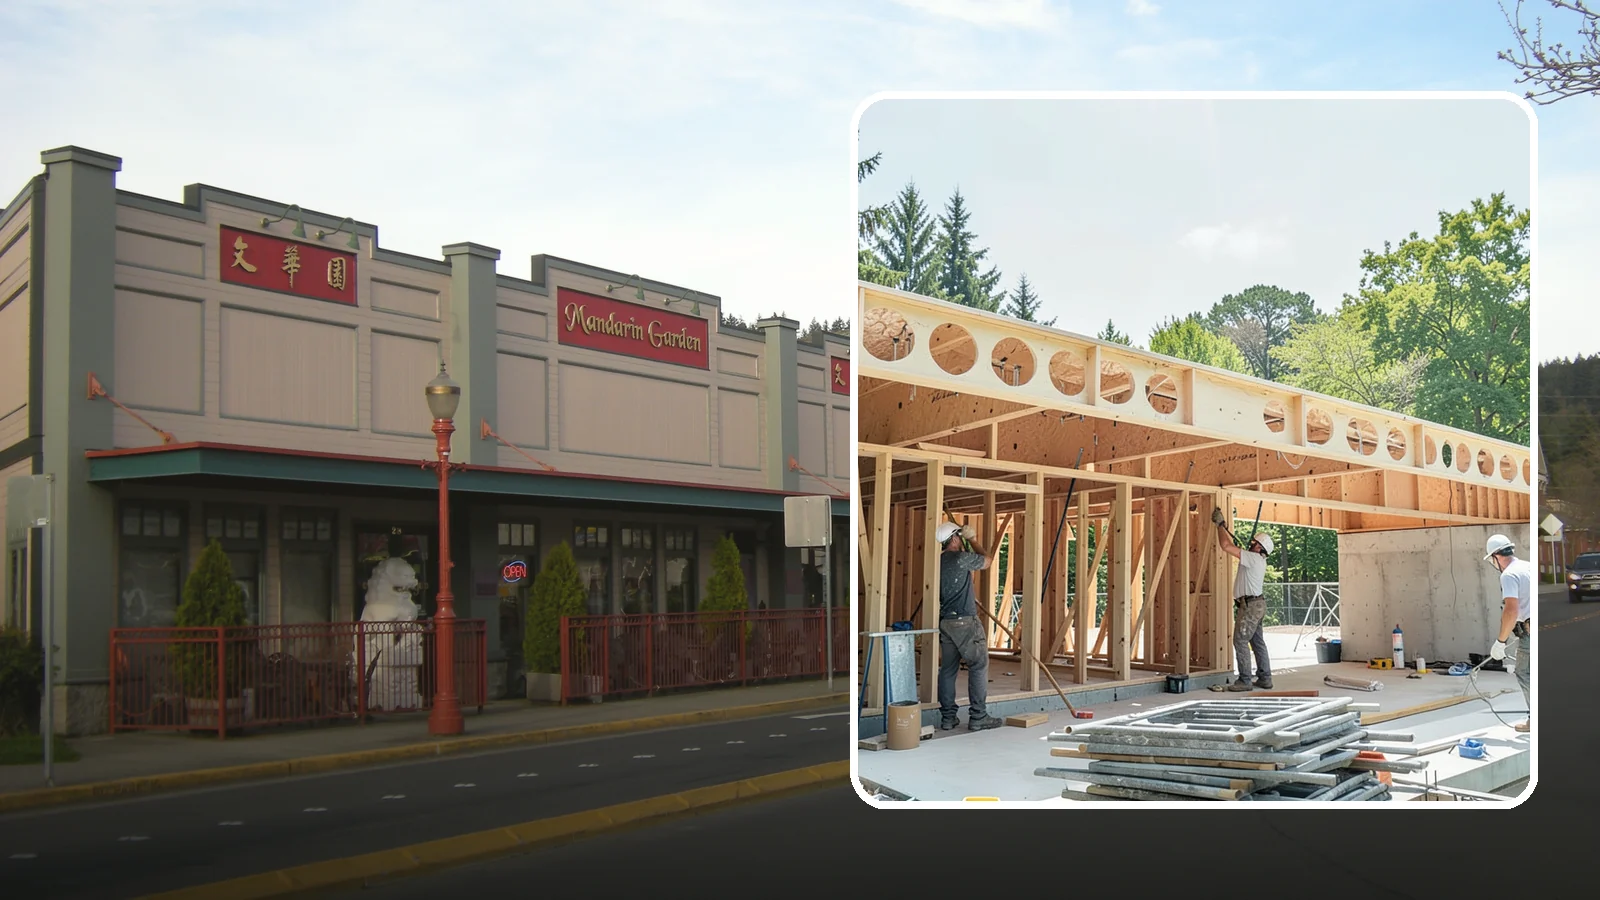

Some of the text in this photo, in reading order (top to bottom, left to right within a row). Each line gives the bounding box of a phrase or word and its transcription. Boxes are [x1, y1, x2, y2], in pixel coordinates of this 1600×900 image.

[231, 235, 347, 291] 文華園
[564, 302, 701, 352] Mandarin Garden
[503, 565, 527, 579] OPEN
